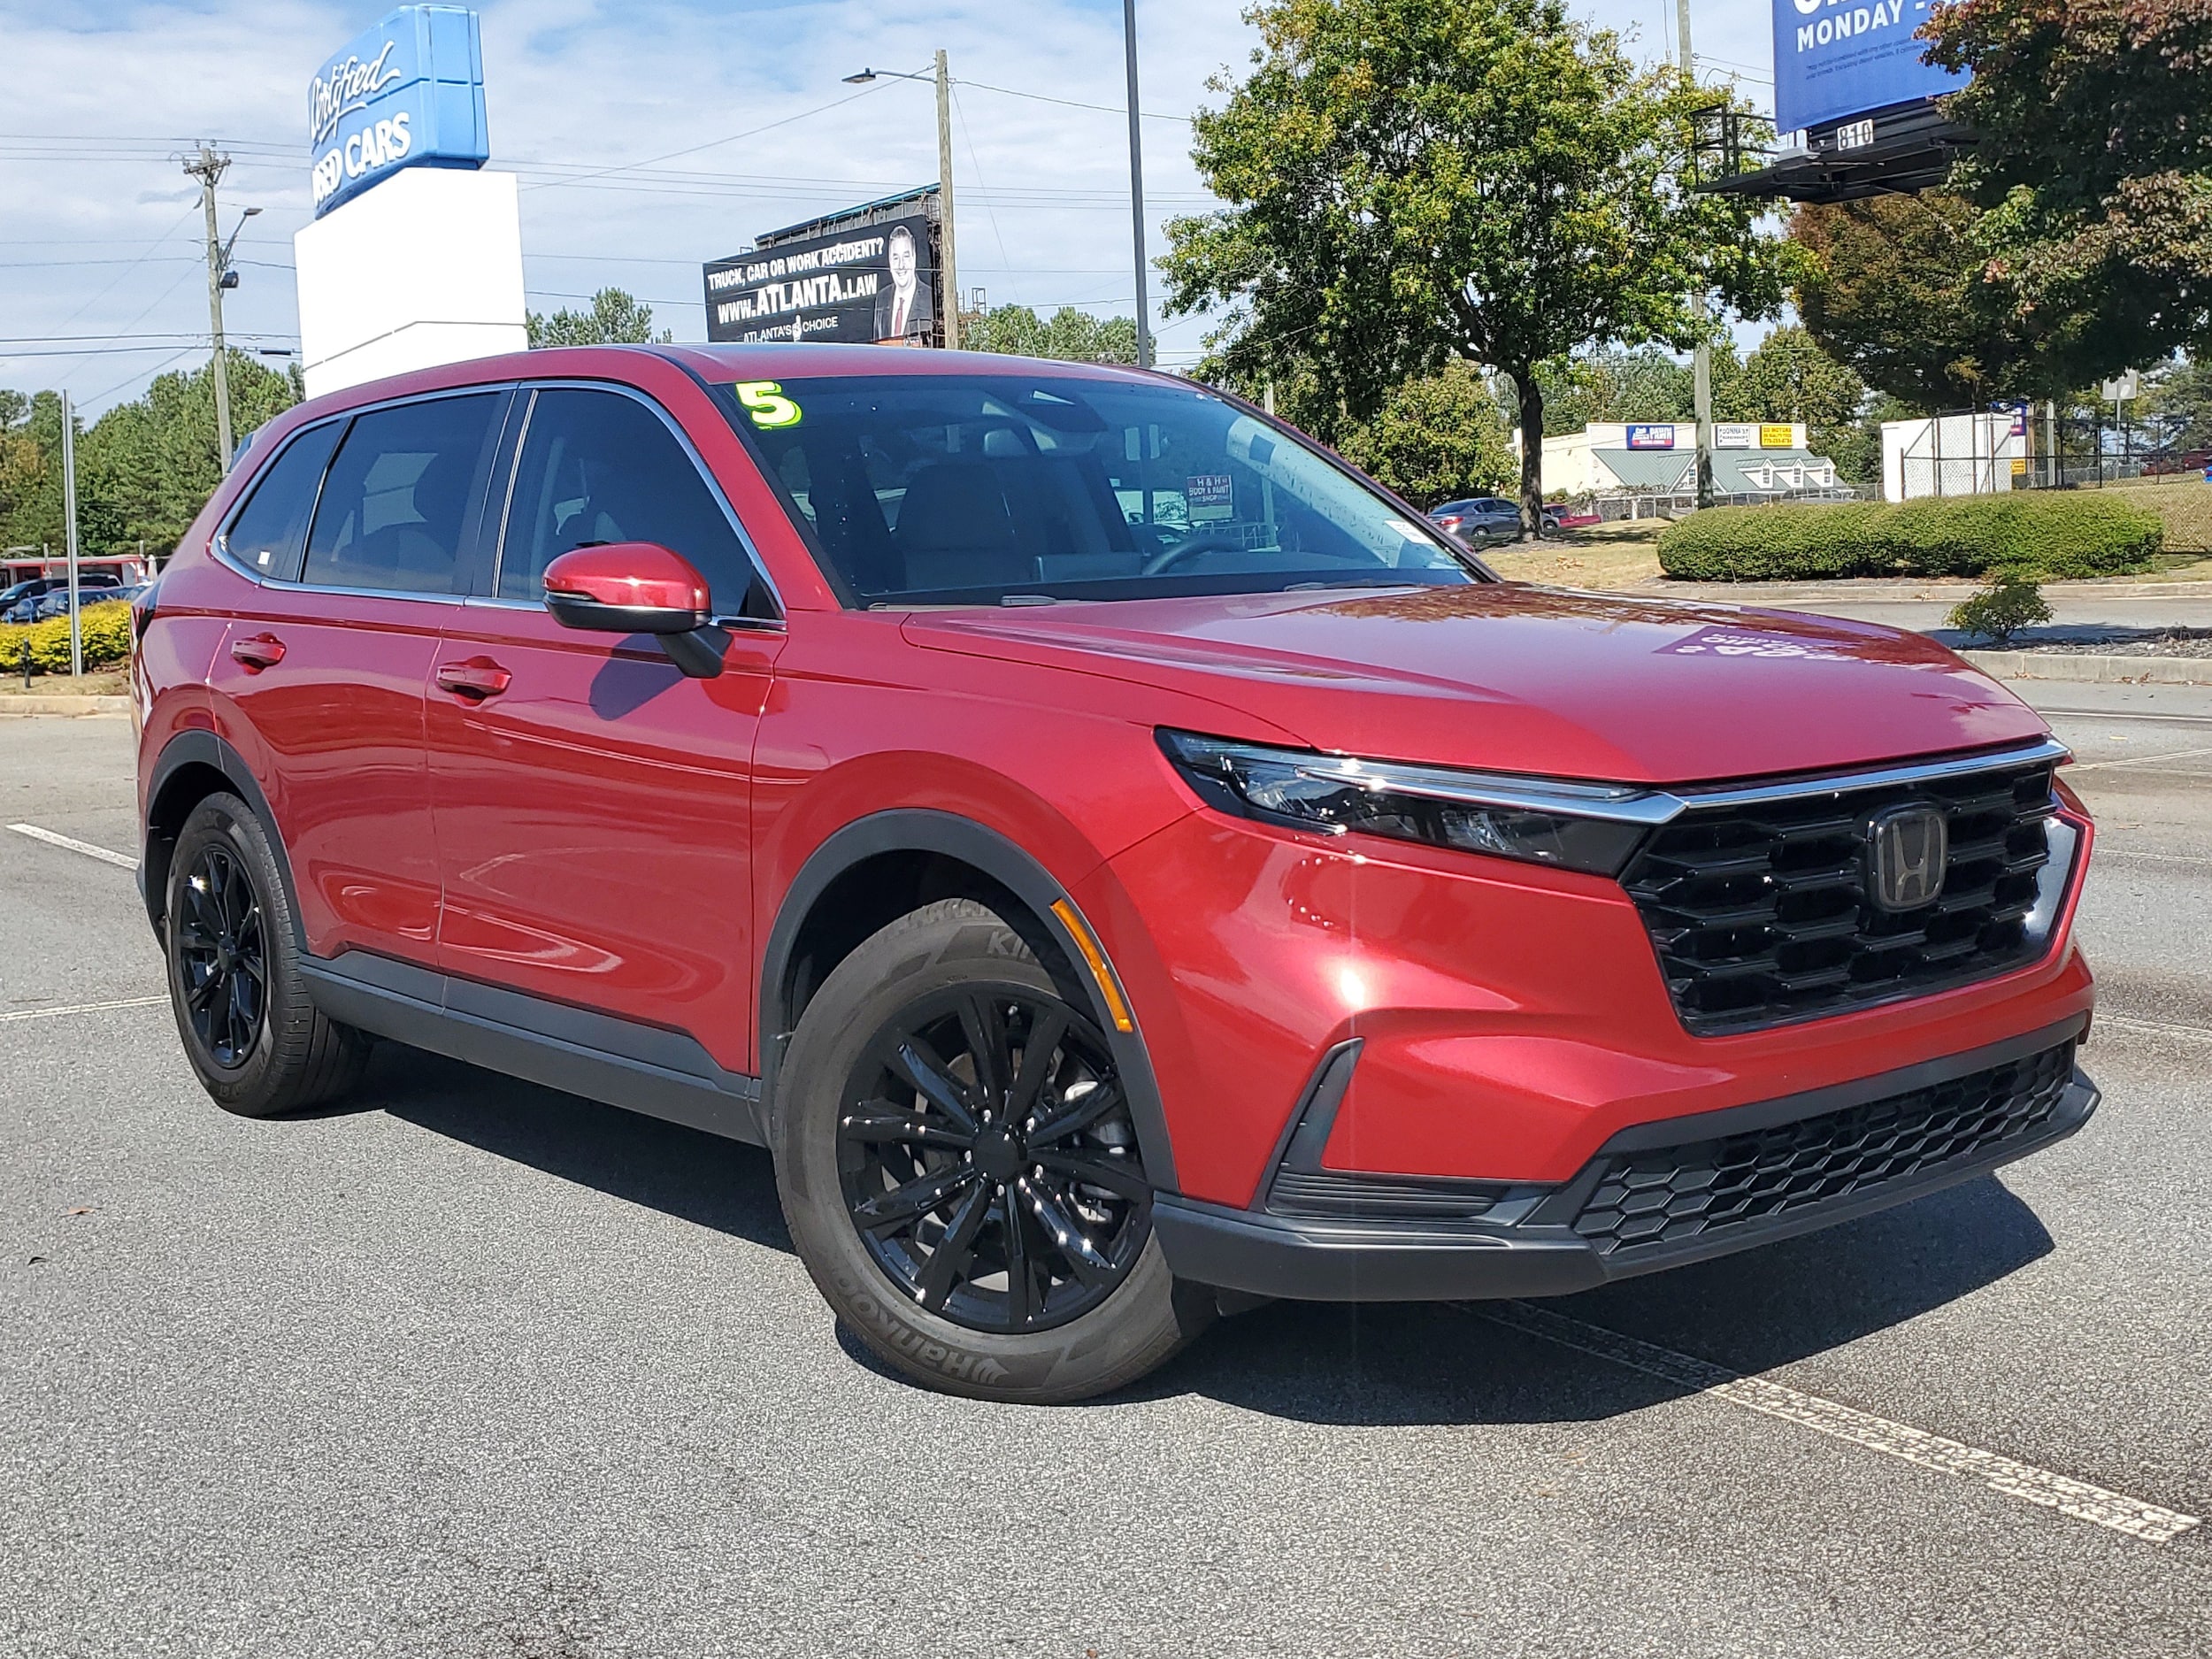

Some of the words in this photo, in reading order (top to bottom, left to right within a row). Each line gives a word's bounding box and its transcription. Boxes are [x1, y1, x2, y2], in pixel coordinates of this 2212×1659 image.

[1797, 0, 1902, 53] MONDAY
[311, 41, 401, 145] Certified
[345, 112, 410, 178] CARS
[1839, 122, 1871, 148] 810
[708, 267, 746, 290] TRUCK,
[747, 262, 769, 282] CAR
[770, 258, 786, 278] OR
[787, 250, 822, 273] WORK
[821, 237, 884, 267] ACCIDENT?
[718, 273, 878, 325] WWW.ATLANTA.LAW
[803, 317, 839, 333] CHOICE
[736, 380, 803, 426] 5
[1196, 478, 1204, 487] H
[1206, 478, 1212, 487] &
[1212, 485, 1229, 494] PAINT
